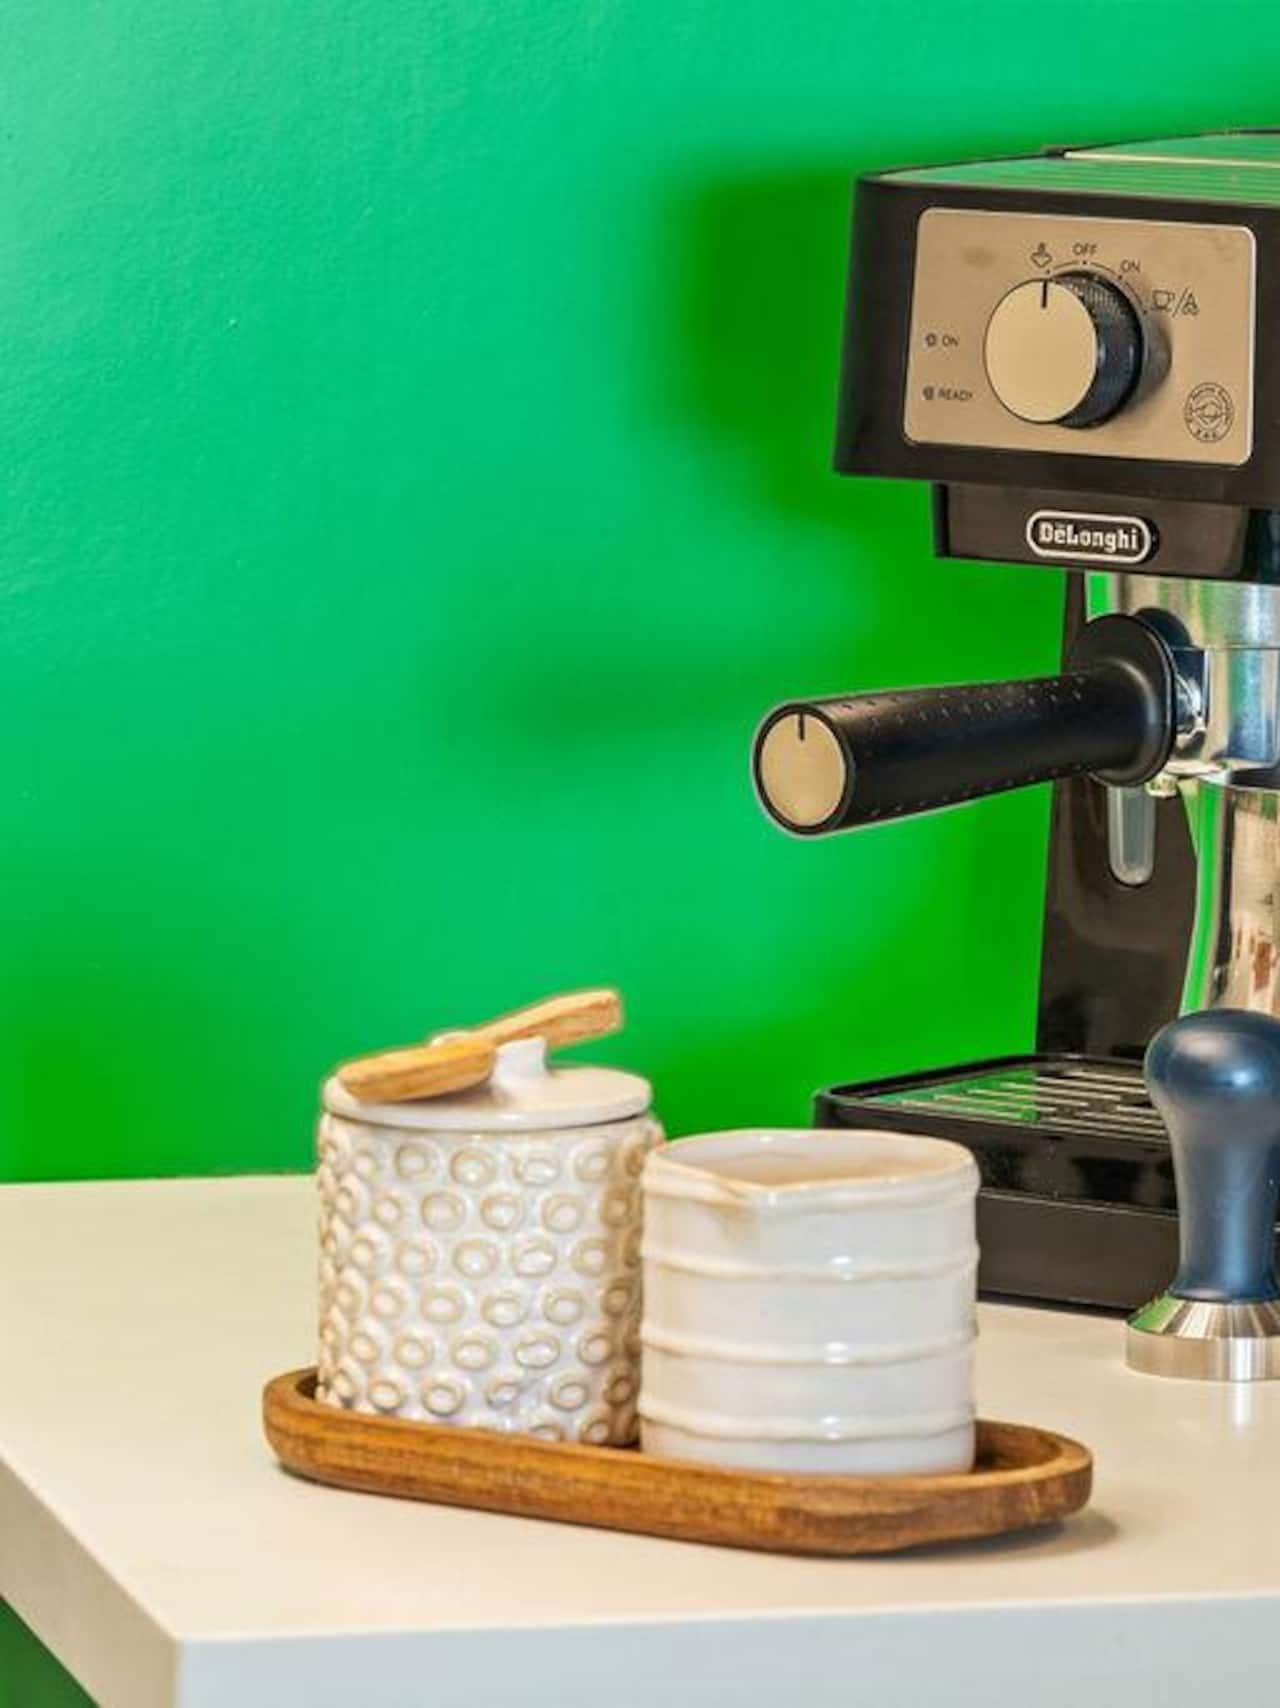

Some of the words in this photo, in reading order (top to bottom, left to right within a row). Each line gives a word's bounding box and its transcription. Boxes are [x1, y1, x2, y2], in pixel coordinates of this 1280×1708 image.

[1072, 243, 1098, 257] OFF
[1120, 259, 1141, 273] ON
[941, 333, 960, 348] ON
[938, 386, 975, 402] READY
